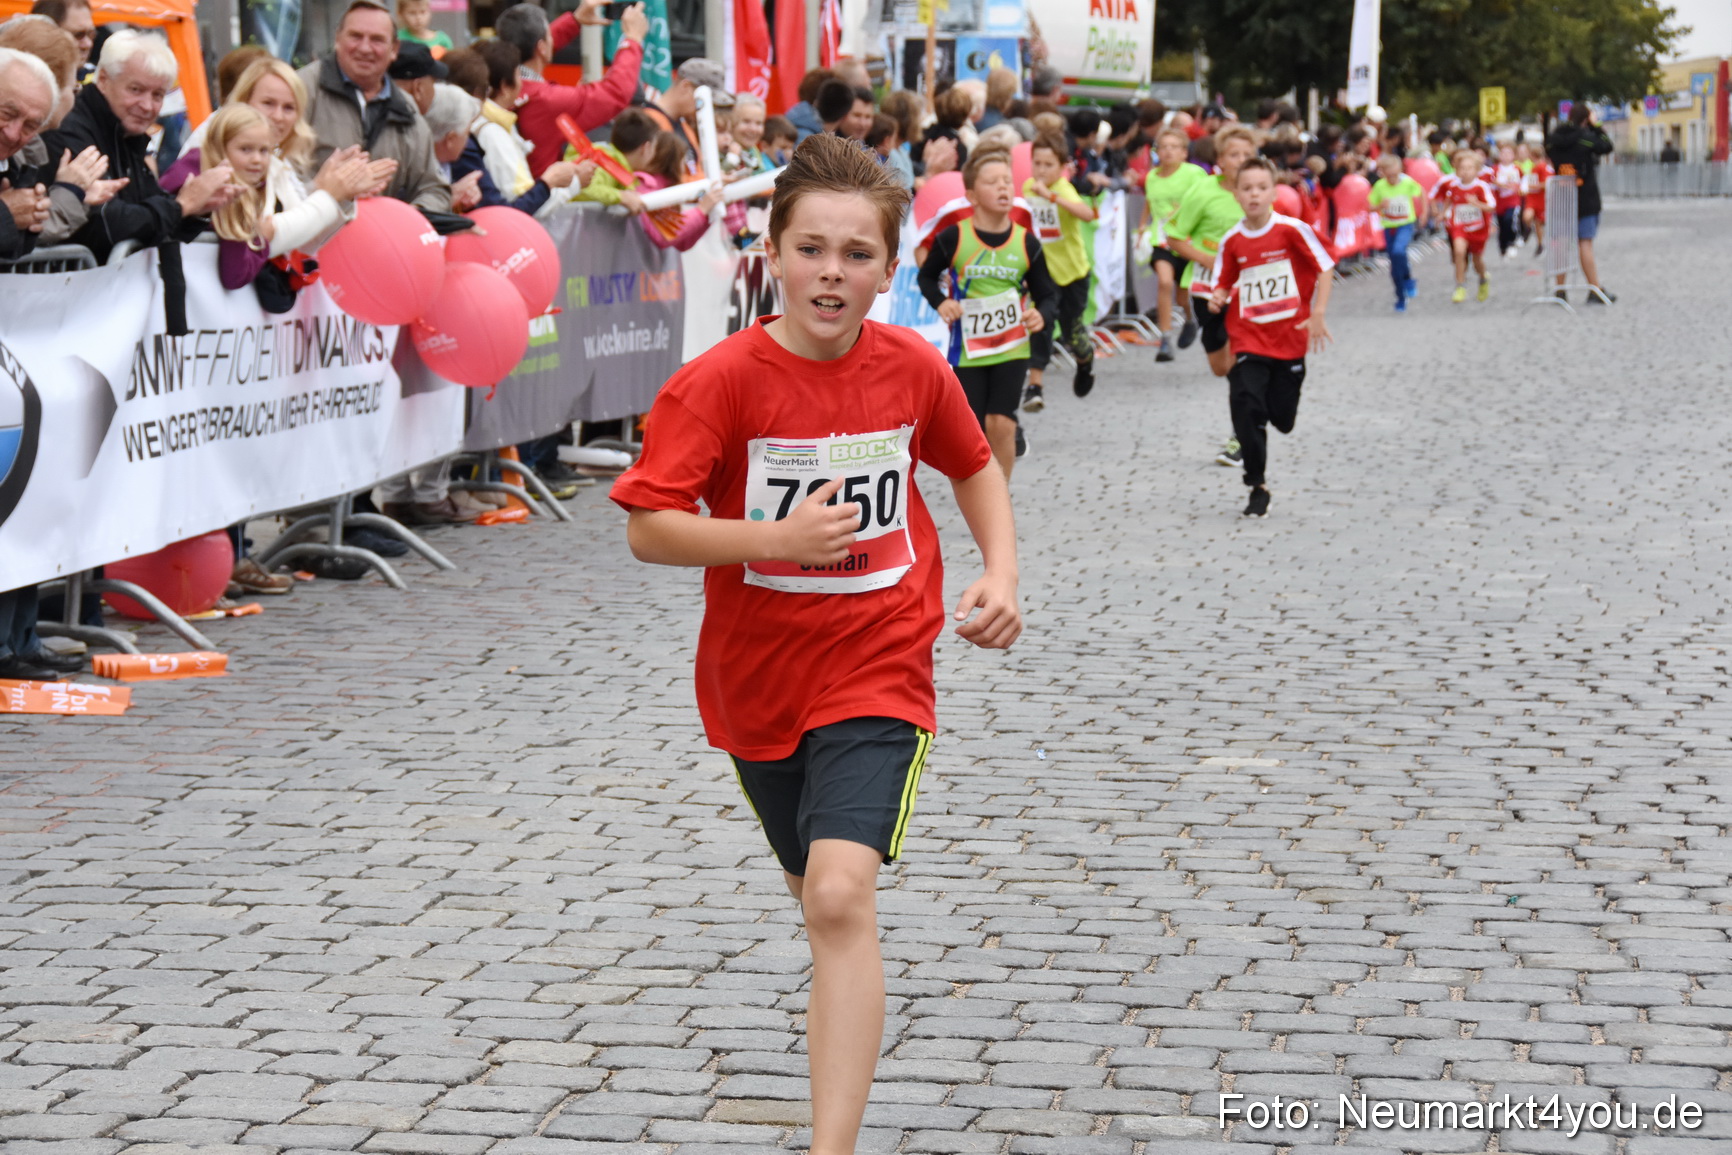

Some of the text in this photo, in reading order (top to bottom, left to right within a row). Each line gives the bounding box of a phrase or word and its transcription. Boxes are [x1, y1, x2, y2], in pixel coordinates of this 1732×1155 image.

[1244, 275, 1289, 303] 7127
[968, 304, 1017, 334] 7239
[763, 455, 819, 466] NeuerMarkt
[829, 435, 901, 462] BOCK
